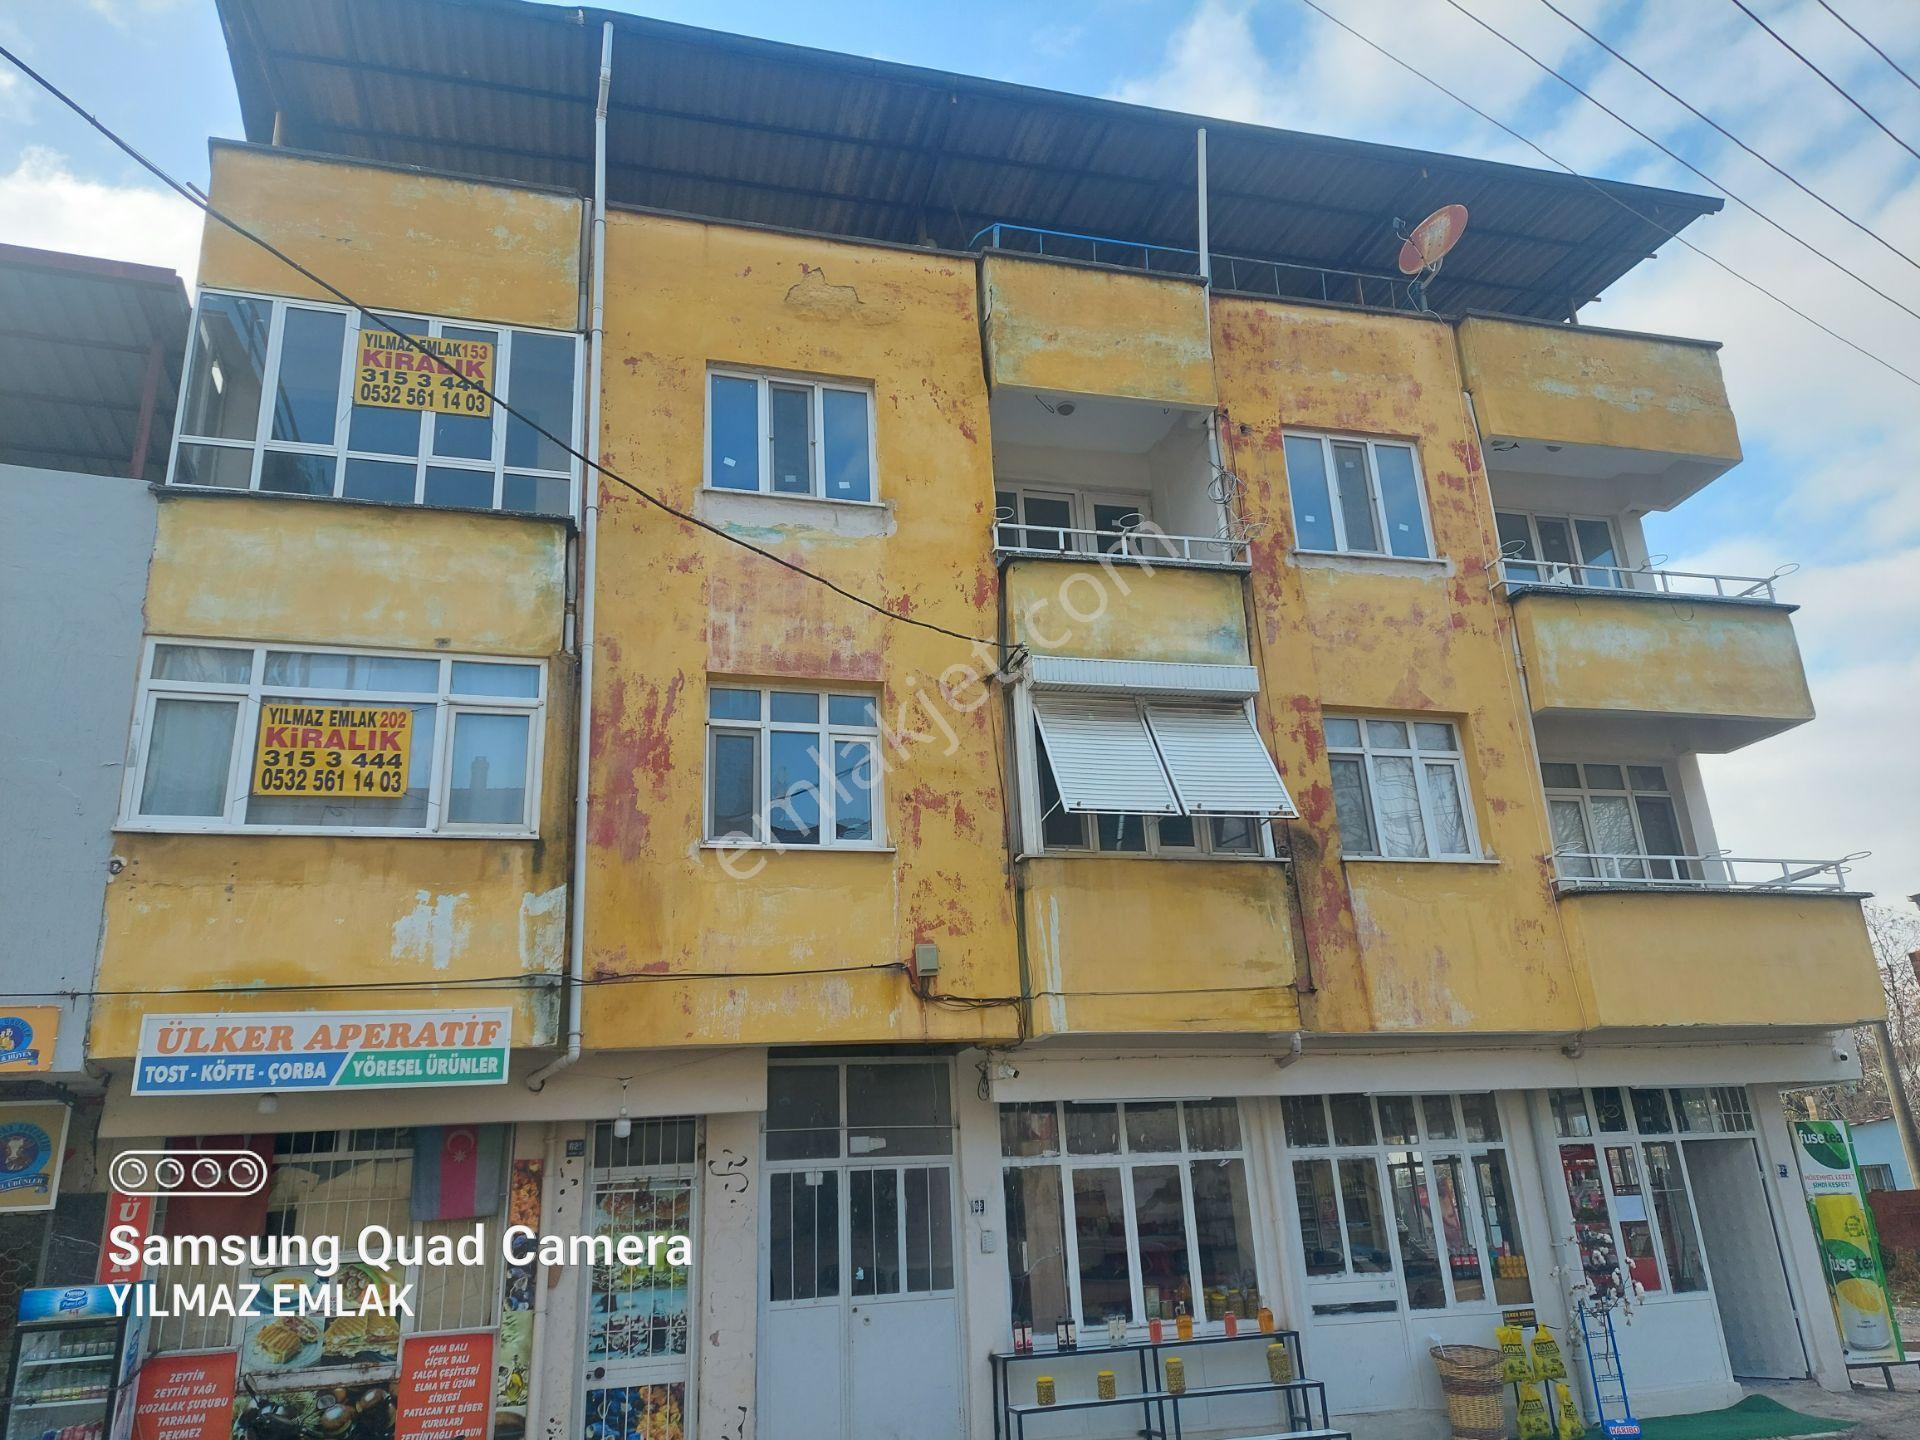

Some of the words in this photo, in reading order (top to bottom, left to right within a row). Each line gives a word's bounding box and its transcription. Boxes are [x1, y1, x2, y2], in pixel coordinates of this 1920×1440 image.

[365, 333, 414, 352] YILMAZ
[419, 339, 462, 357] EMLAK
[462, 344, 488, 360] 153
[361, 368, 408, 385] 315
[417, 373, 431, 388] 3
[440, 376, 485, 393] 444
[360, 383, 401, 403] 0532
[406, 387, 434, 407] 561
[442, 391, 461, 409] 14
[465, 393, 485, 412] 03
[269, 708, 324, 727] YILMAZ
[329, 711, 377, 728] EMLAK
[379, 711, 406, 729] 202
[264, 749, 315, 767] 315
[326, 751, 342, 768] 3
[351, 752, 402, 769] 444
[261, 767, 307, 791] 0532
[313, 769, 345, 792] 561
[354, 770, 374, 792] 14
[380, 770, 402, 793] 03
[157, 1020, 295, 1054] ÜLKER
[303, 1014, 502, 1050] APERATİF
[145, 1065, 189, 1084] TOST
[200, 1059, 256, 1083] KÖFTE
[268, 1061, 327, 1085] ÇORBA
[353, 1055, 423, 1078] YÖRESEL
[426, 1053, 498, 1076] ÜRÜNLER
[428, 1344, 447, 1356] ÇAM
[449, 1343, 468, 1352] BALI
[425, 1355, 449, 1368] ÇİÇEK
[451, 1355, 470, 1364] BALI
[168, 1369, 205, 1383] ZEYTİN
[412, 1369, 438, 1380] SALÇA
[440, 1364, 481, 1378] ÇEŞİTLERİ
[153, 1384, 190, 1398] ZEYTİN
[192, 1382, 217, 1396] YAĞI
[414, 1382, 437, 1392] ELMA
[440, 1381, 450, 1390] VE
[452, 1378, 476, 1389] ÜZÜM
[428, 1390, 462, 1403] SİRKESİ
[138, 1401, 185, 1414] KOZALAK
[187, 1397, 229, 1412] ŞURUBU
[403, 1407, 443, 1418] PATLICAN
[445, 1405, 456, 1414] VE
[458, 1402, 483, 1413] BİBER
[157, 1413, 206, 1427] TARHANA
[421, 1416, 464, 1428] KURULARI
[158, 1428, 202, 1440] PEKMEZ
